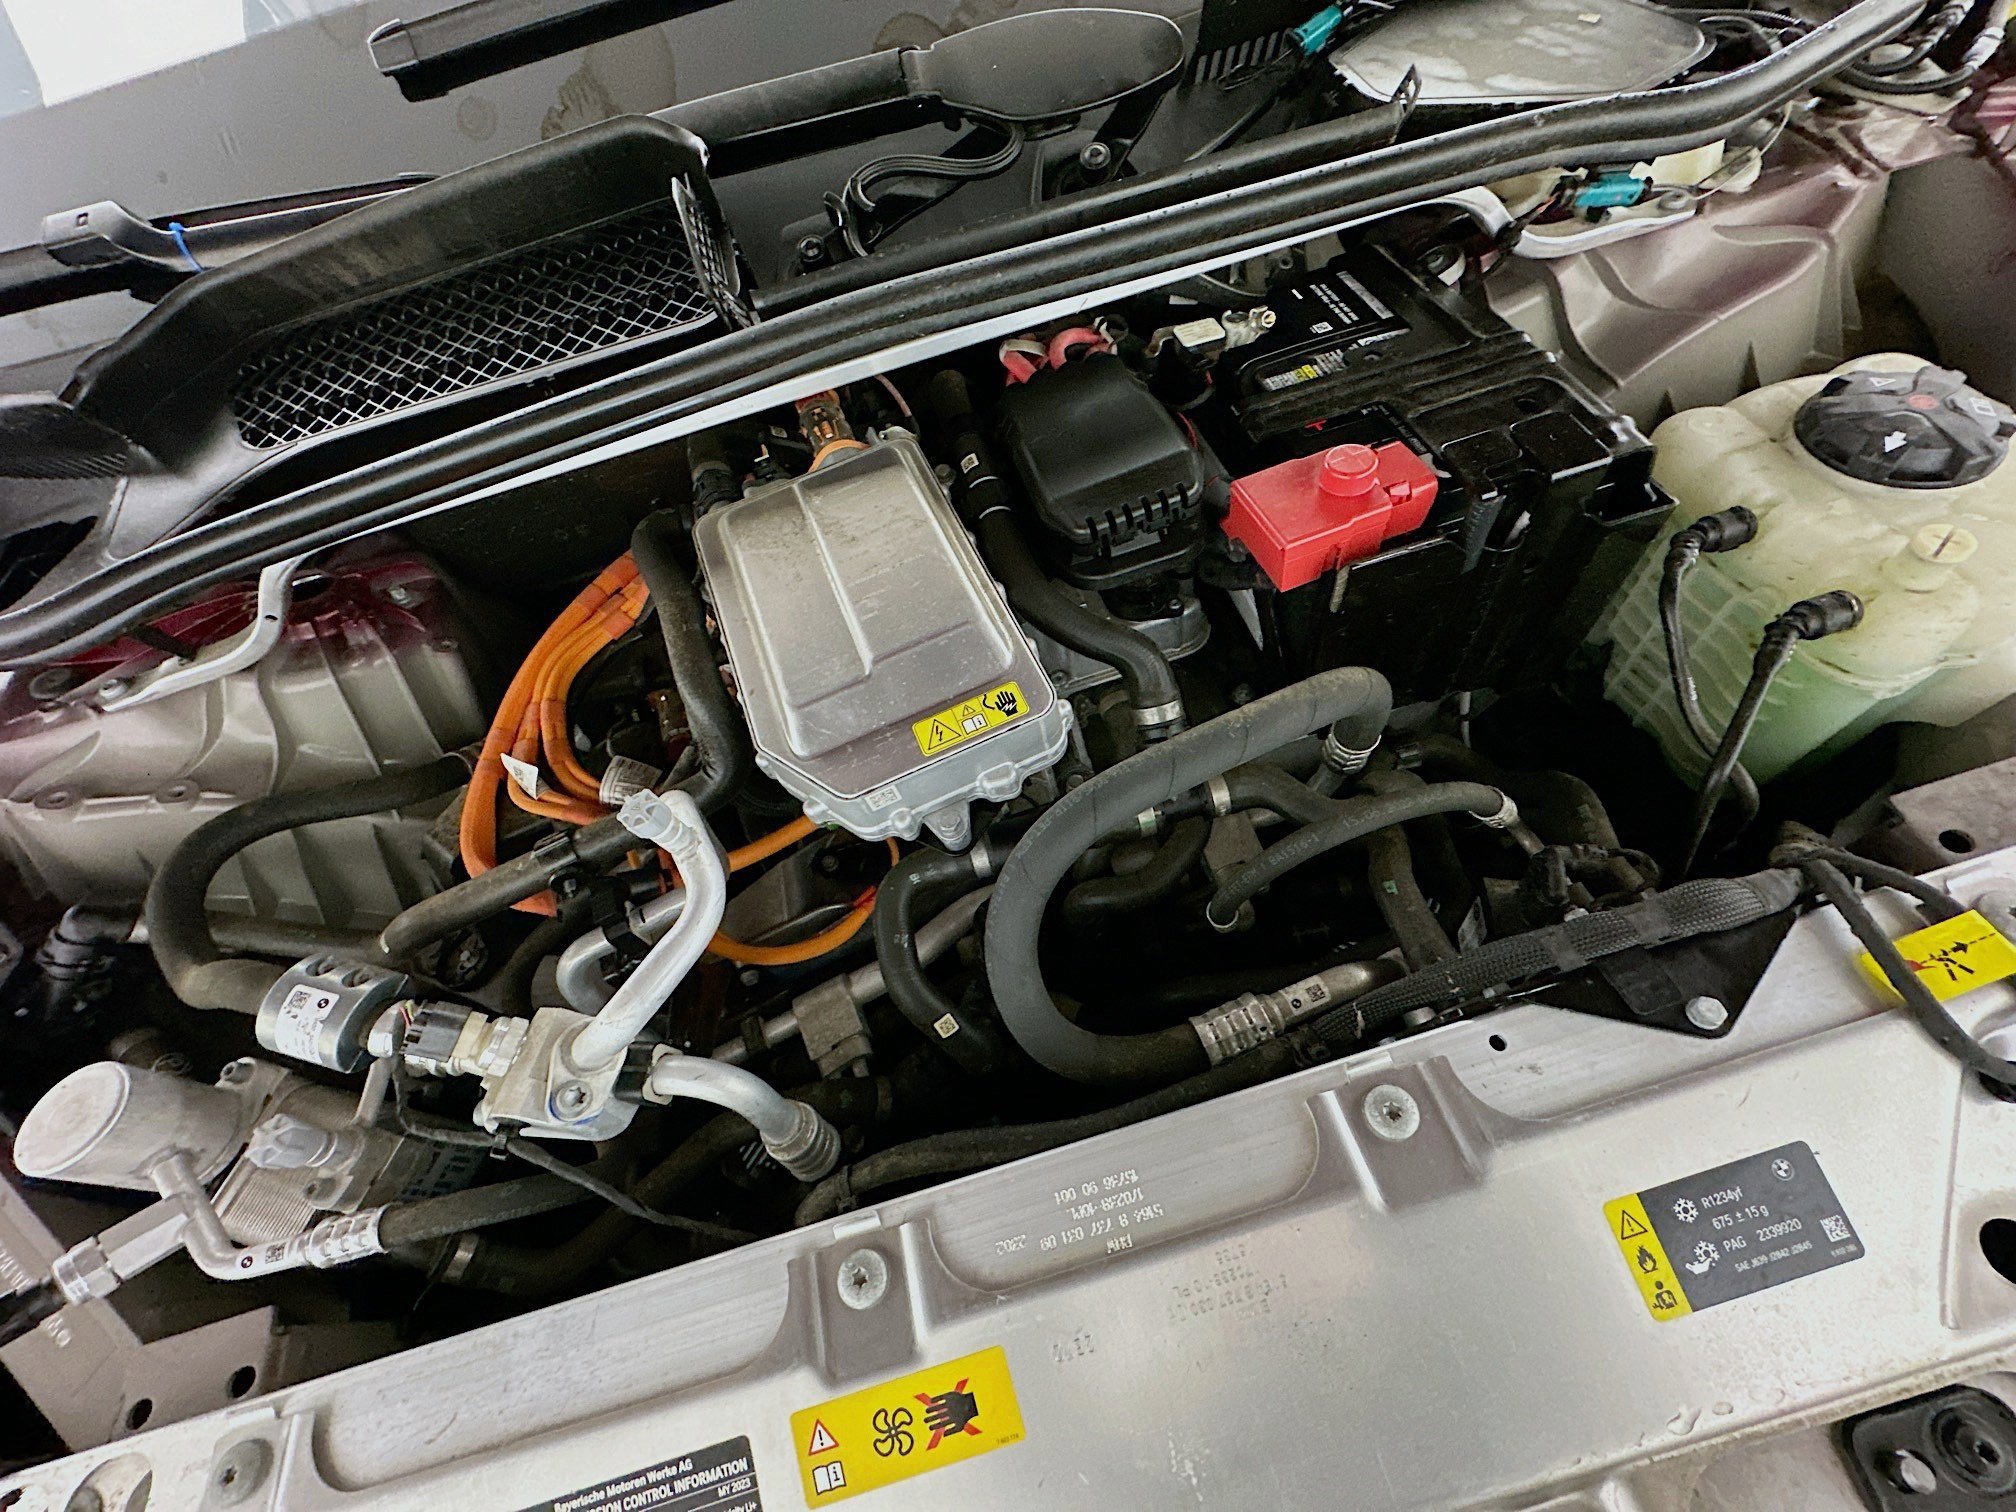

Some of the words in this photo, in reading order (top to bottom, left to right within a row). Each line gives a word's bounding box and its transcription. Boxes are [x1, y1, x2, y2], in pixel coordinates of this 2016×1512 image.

[1701, 1186, 1743, 1209] R1234yf
[1712, 1213, 1733, 1230] 675
[1745, 1206, 1760, 1221] 15
[1759, 1204, 1769, 1218] g
[1723, 1235, 1747, 1253] PAG
[1756, 1217, 1802, 1242] 2339920
[1734, 1260, 1751, 1273] SAE
[554, 1490, 606, 1512] Bayerische
[606, 1475, 647, 1498] Motoren
[646, 1465, 678, 1484] Werke
[678, 1458, 693, 1472] AG
[623, 1480, 673, 1511] CONTROL
[673, 1457, 748, 1493] INFORMATION
[718, 1483, 730, 1498] MY
[731, 1477, 751, 1493] 2023
